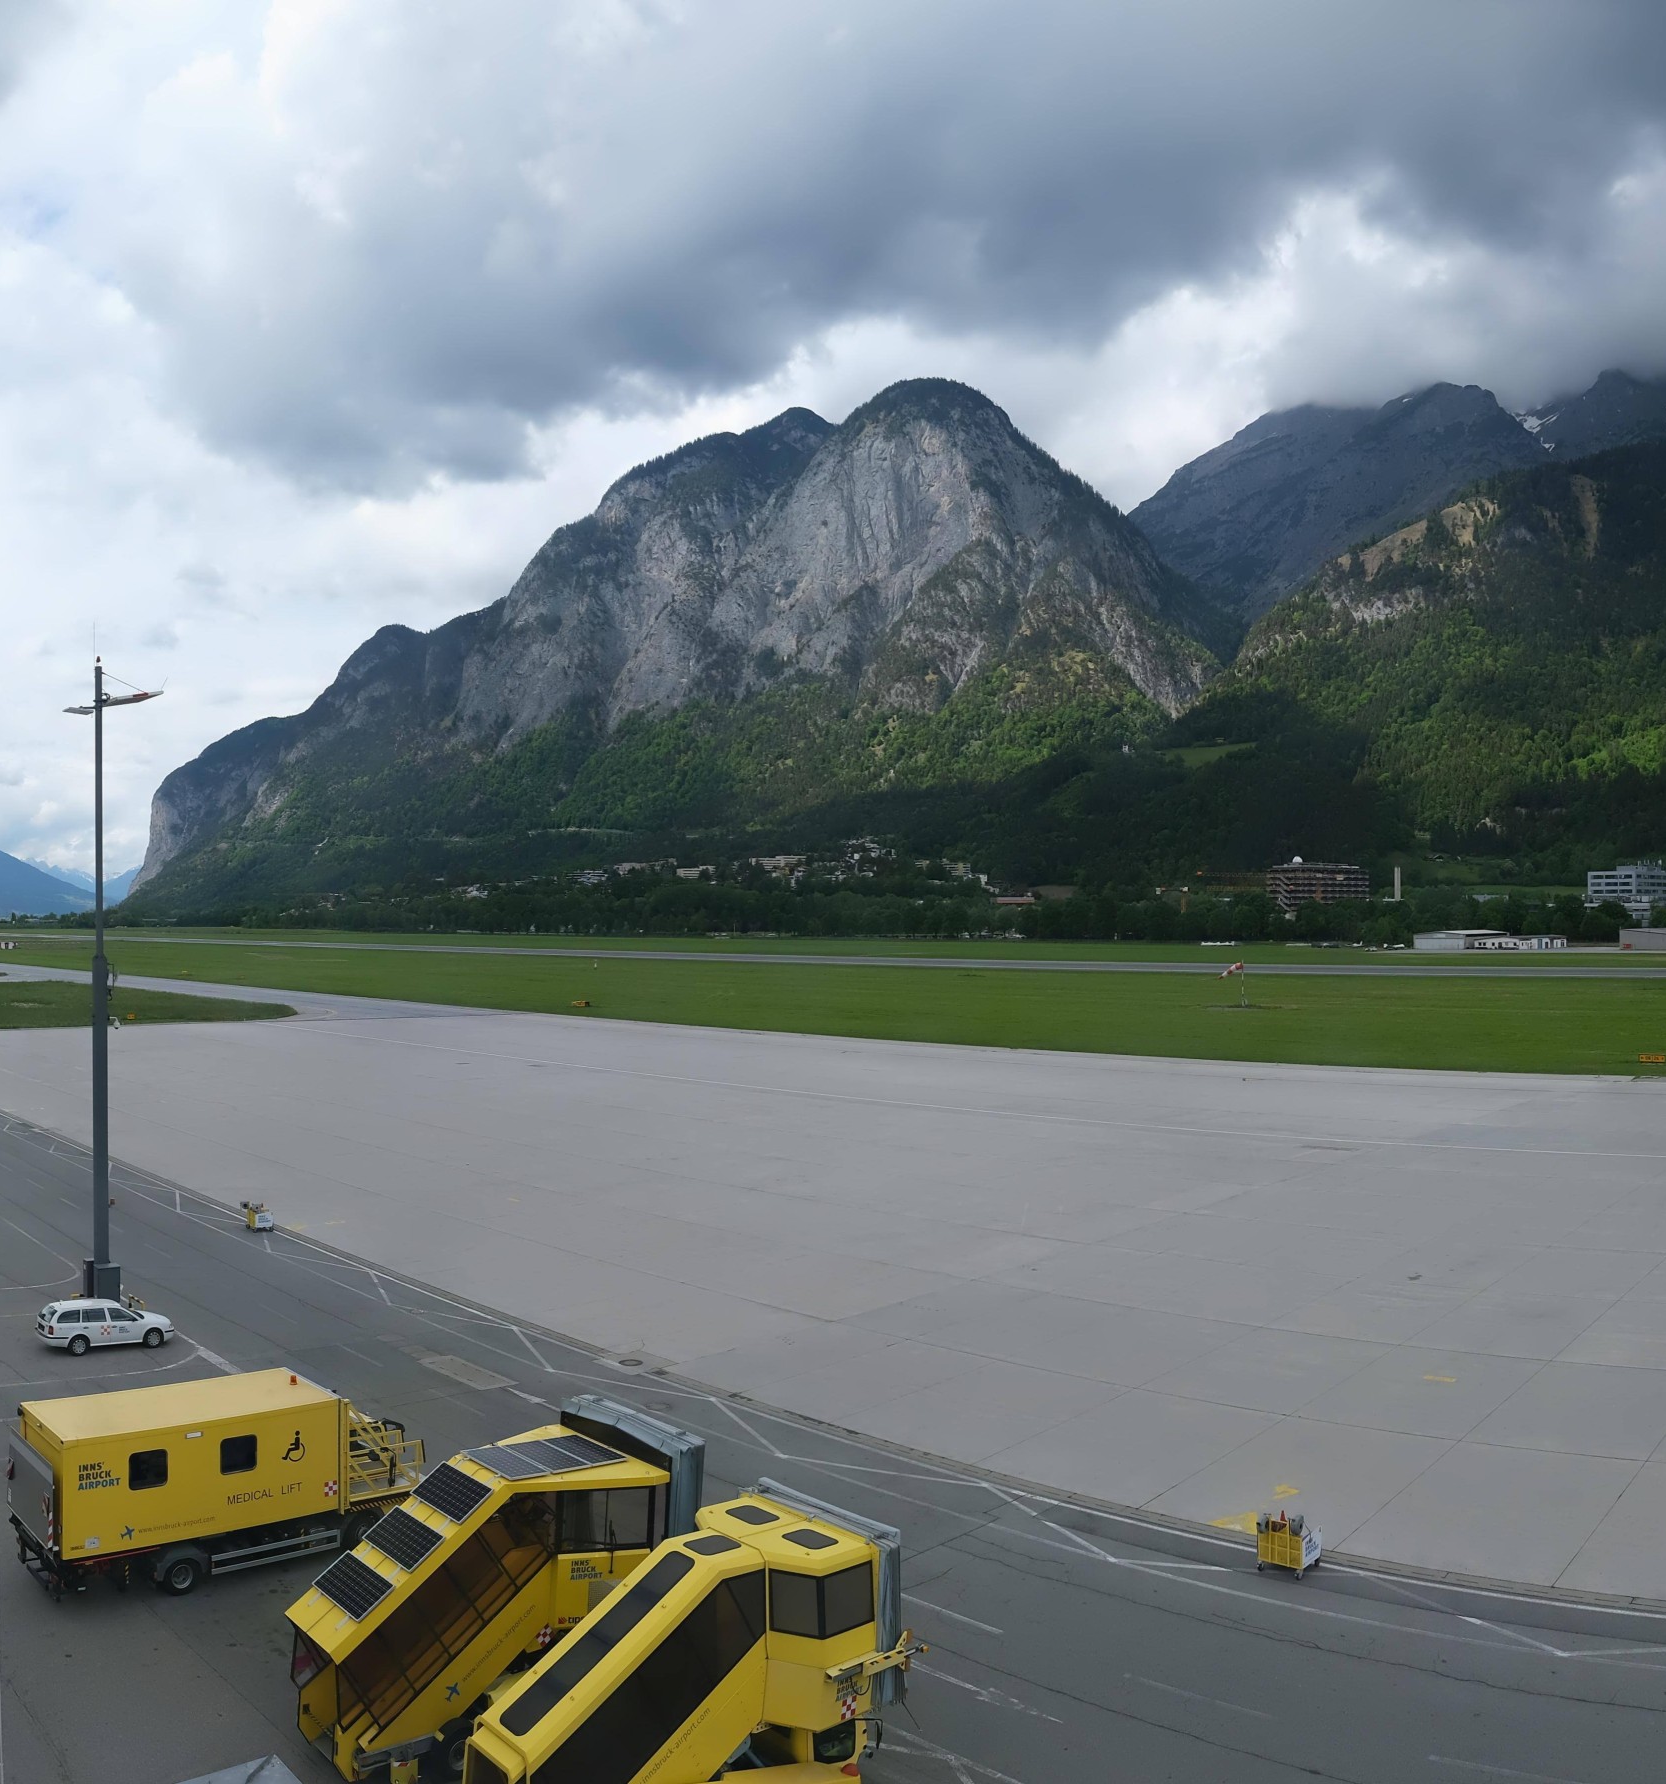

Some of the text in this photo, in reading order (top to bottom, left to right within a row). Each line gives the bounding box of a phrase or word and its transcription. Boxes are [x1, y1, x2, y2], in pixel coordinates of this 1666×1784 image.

[79, 1462, 104, 1472] INNS'
[79, 1470, 111, 1482] BRUCK
[78, 1478, 121, 1491] AIRPORT
[227, 1482, 303, 1505] MEDICAL LIFT
[138, 1515, 215, 1534] www.innsbruck-airport.com
[570, 1572, 603, 1580] AIRPORT
[462, 1604, 536, 1682] www.innsbruck-airport.com
[640, 1707, 711, 1784] .innsbruck-airport.com
